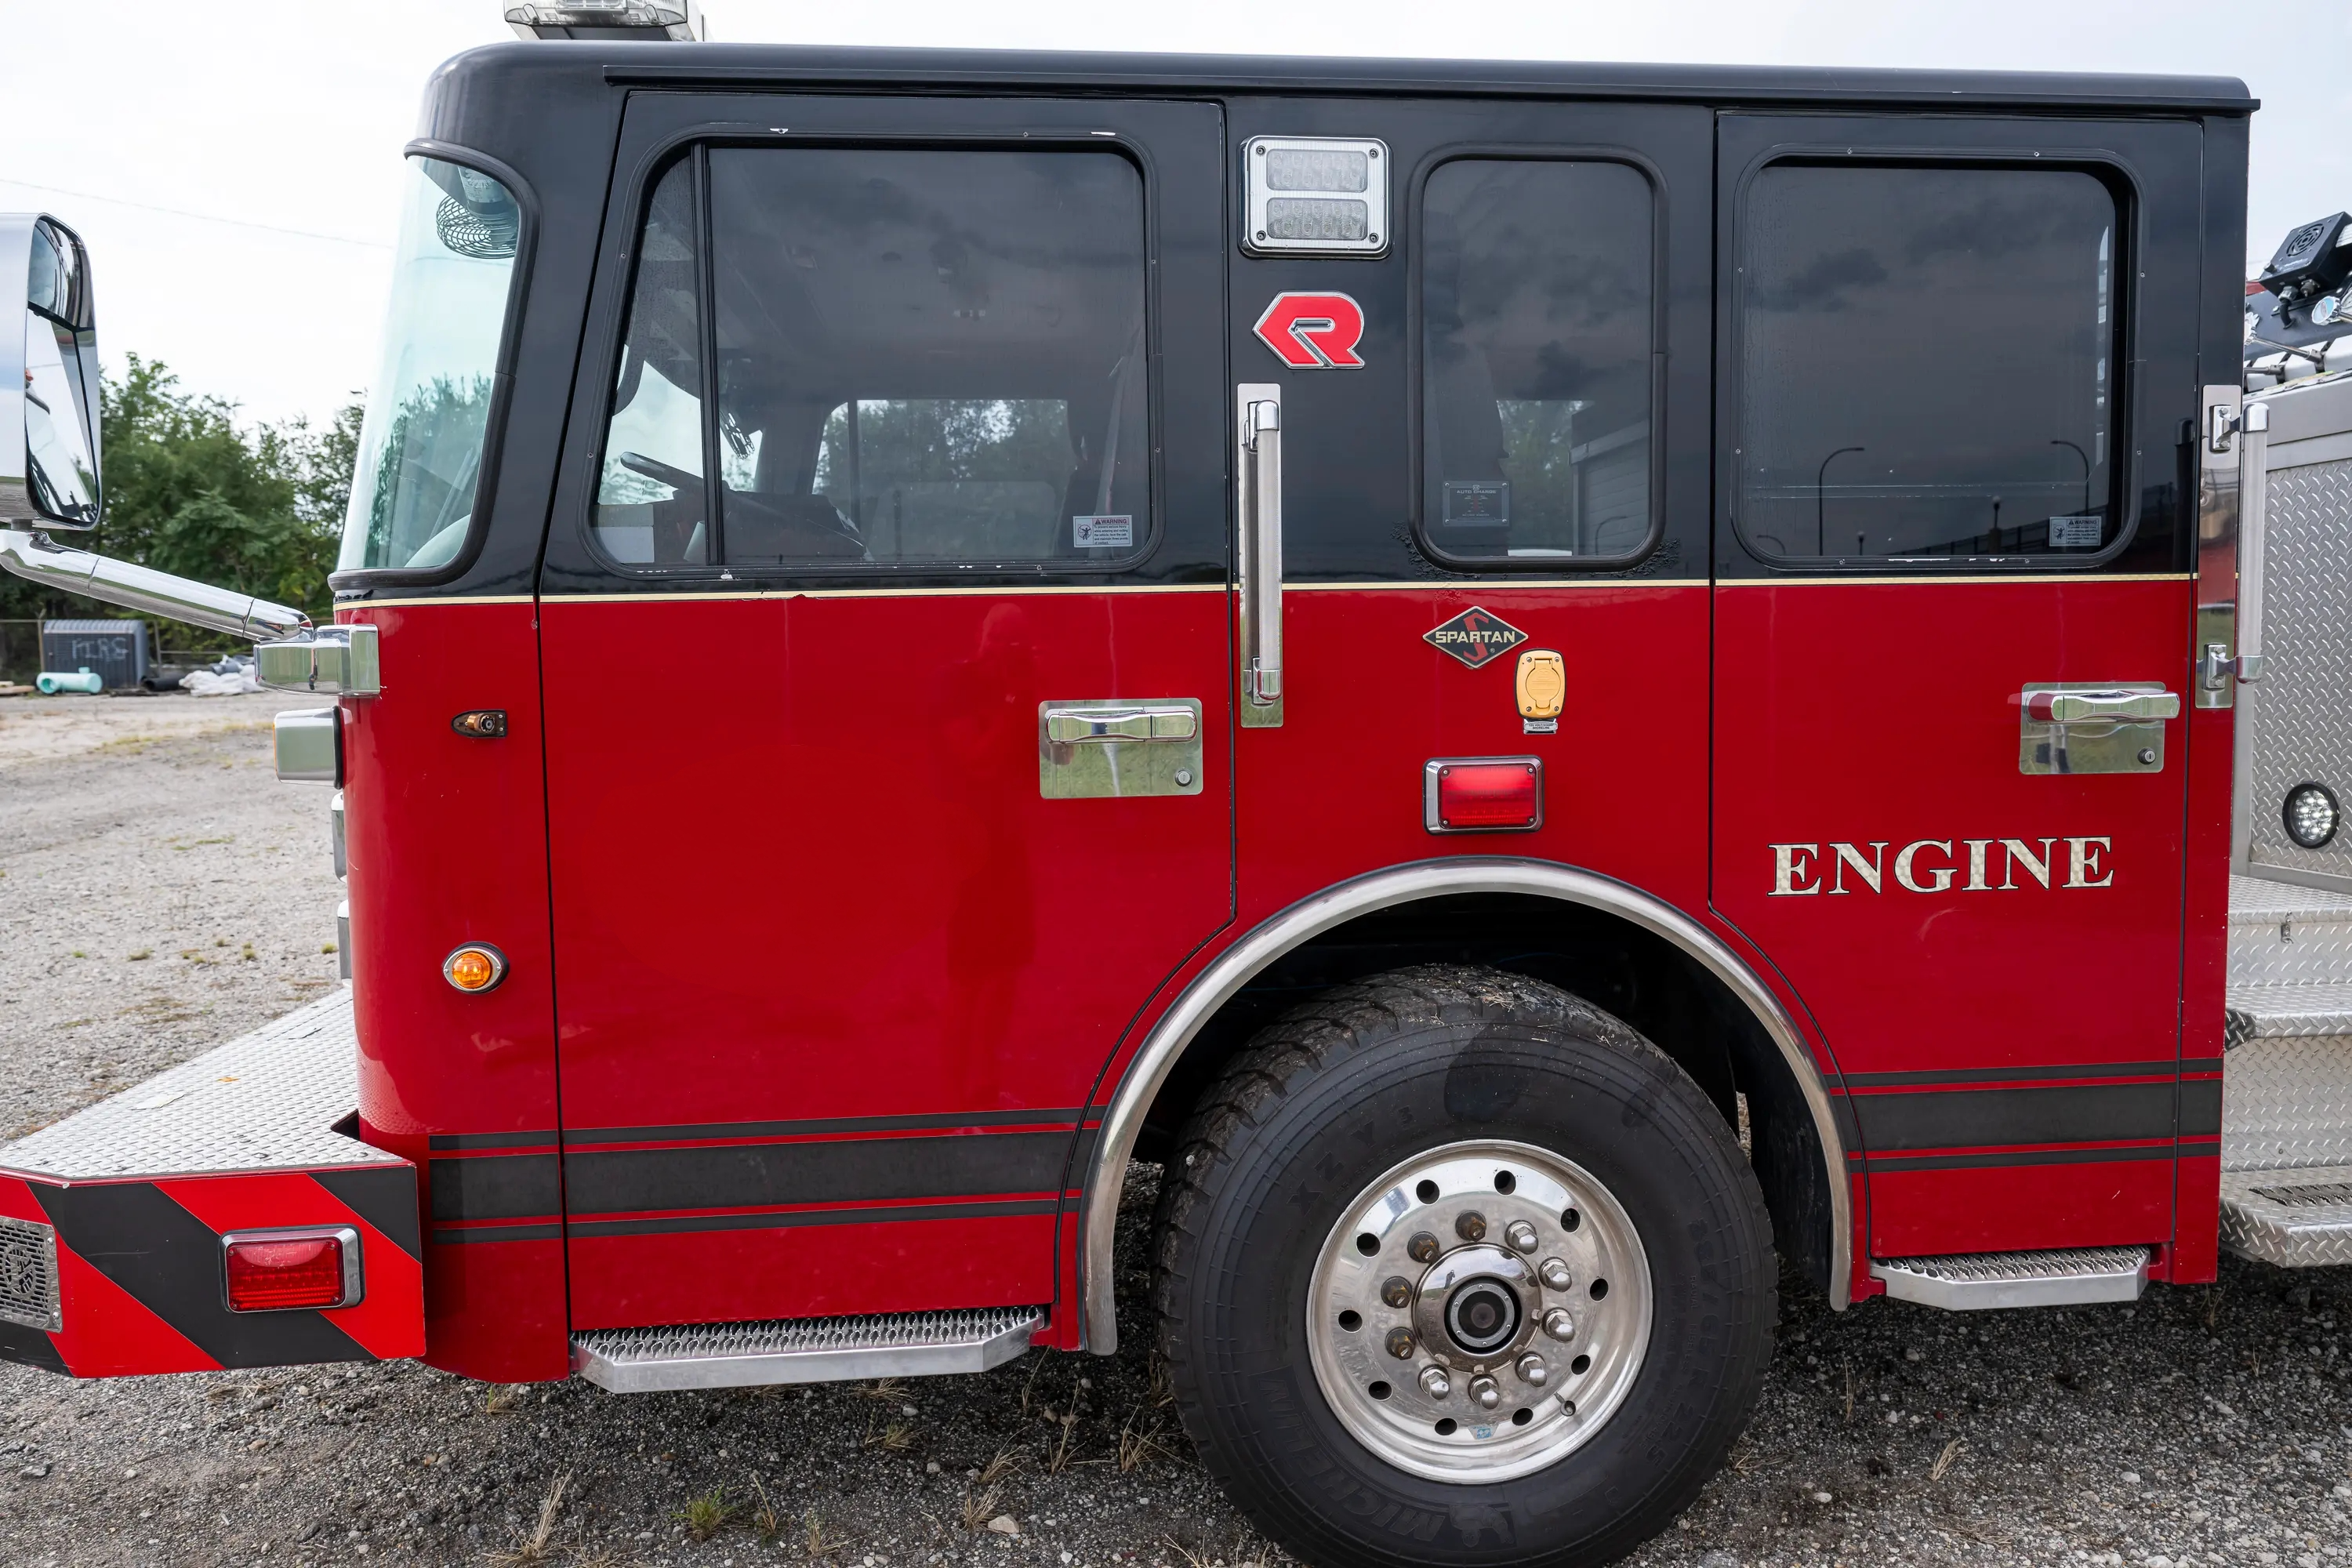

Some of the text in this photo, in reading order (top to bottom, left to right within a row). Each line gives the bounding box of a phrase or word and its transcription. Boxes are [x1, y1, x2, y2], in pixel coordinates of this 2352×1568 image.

[1435, 630, 1515, 644] SPARTAN
[1766, 836, 2114, 896] ENGINE
[1258, 1377, 1447, 1543] MICHELIN
